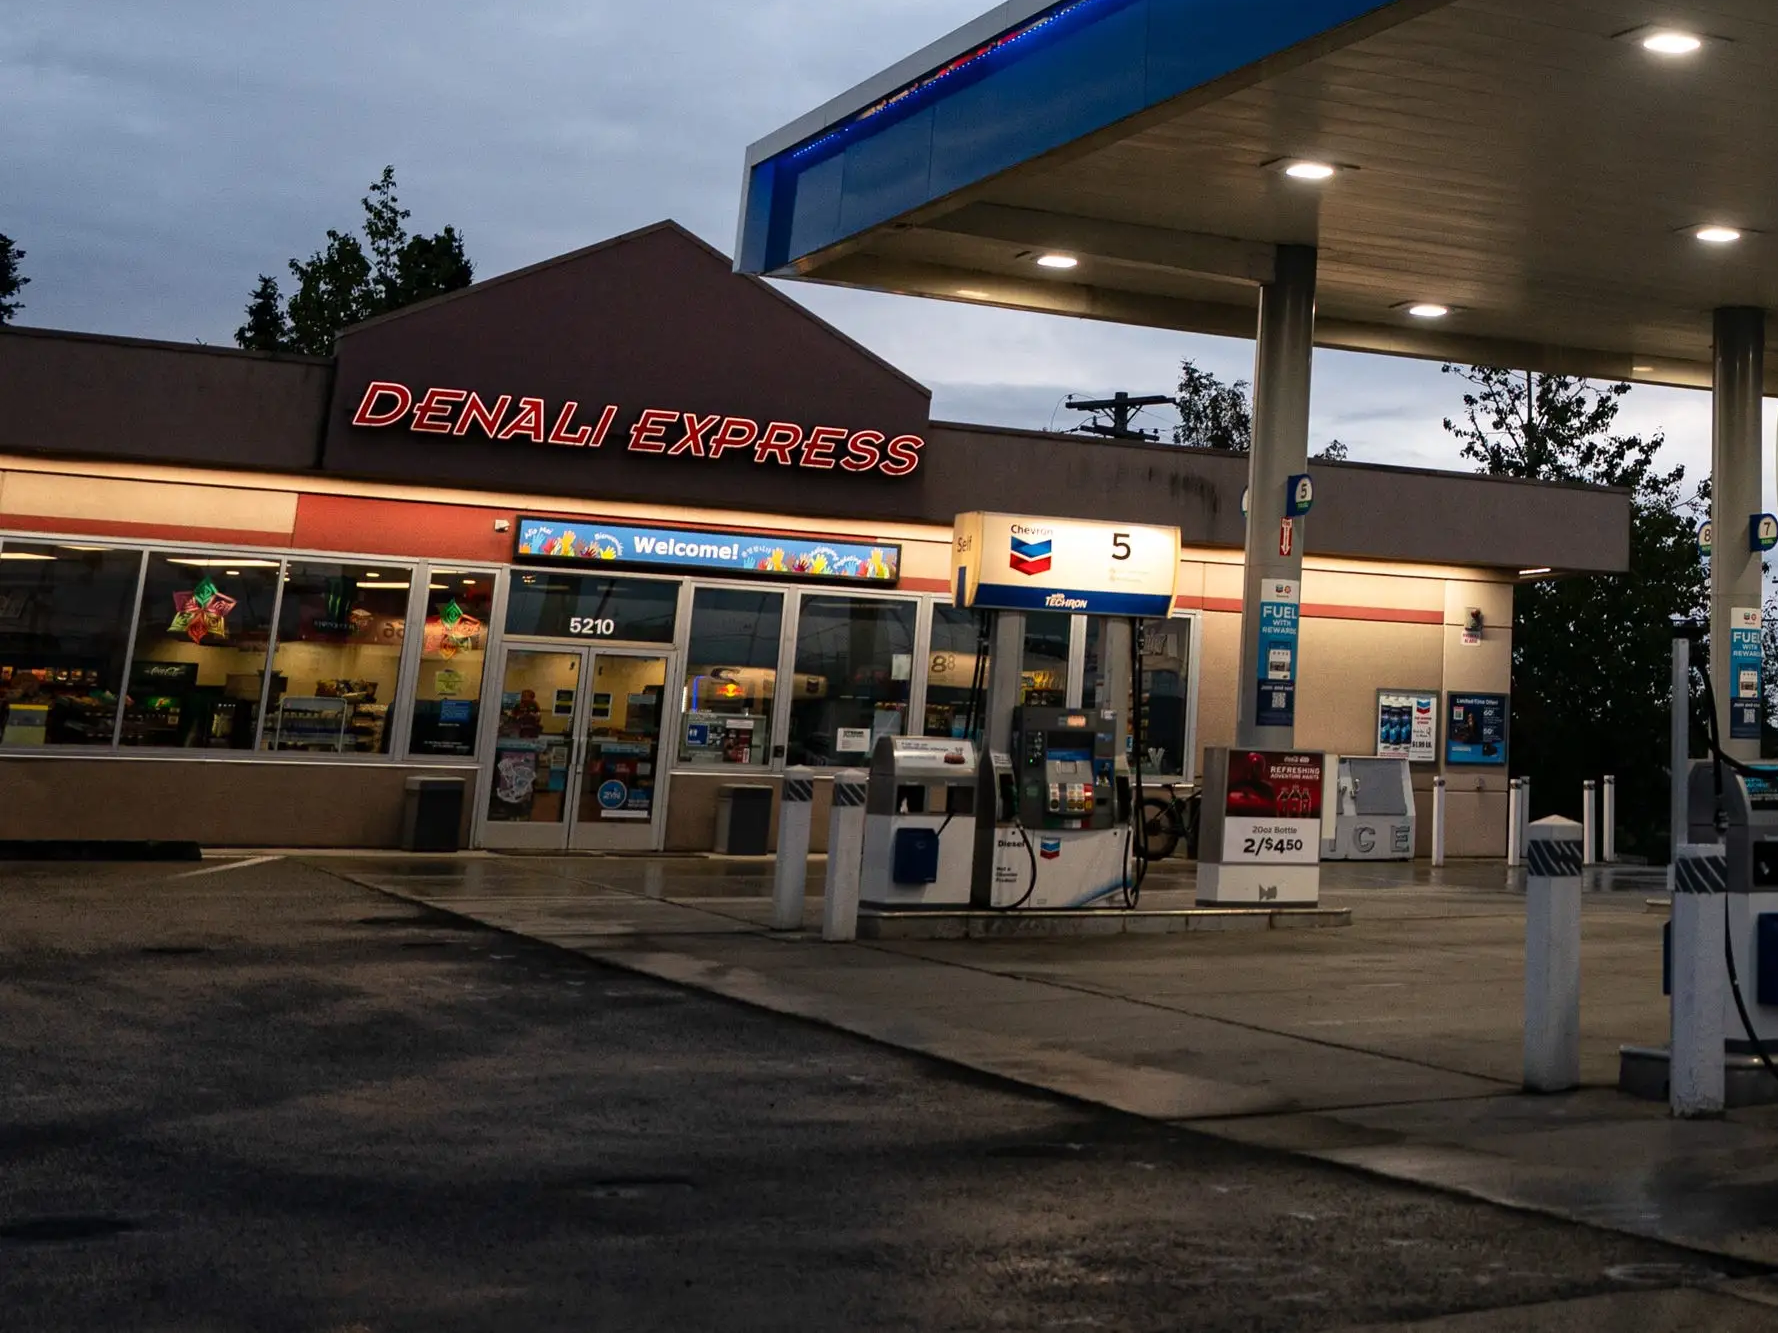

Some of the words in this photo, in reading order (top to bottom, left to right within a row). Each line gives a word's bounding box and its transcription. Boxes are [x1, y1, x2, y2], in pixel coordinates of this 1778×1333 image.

[352, 382, 618, 447] DENALI
[627, 409, 925, 476] EXPRESS
[1300, 483, 1308, 499] 5
[1010, 523, 1054, 536] Chevron
[1704, 529, 1712, 542] 8
[1763, 522, 1771, 536] 7
[634, 536, 739, 560] Welcome!
[957, 537, 972, 553] Self
[1111, 533, 1131, 560] 5
[1045, 596, 1087, 610] TECHRON
[1263, 606, 1297, 619] FUEL
[569, 617, 614, 635] 5210
[1273, 619, 1292, 627] WITH
[1270, 766, 1320, 775] REFRESHING
[1274, 826, 1298, 834] Bottle
